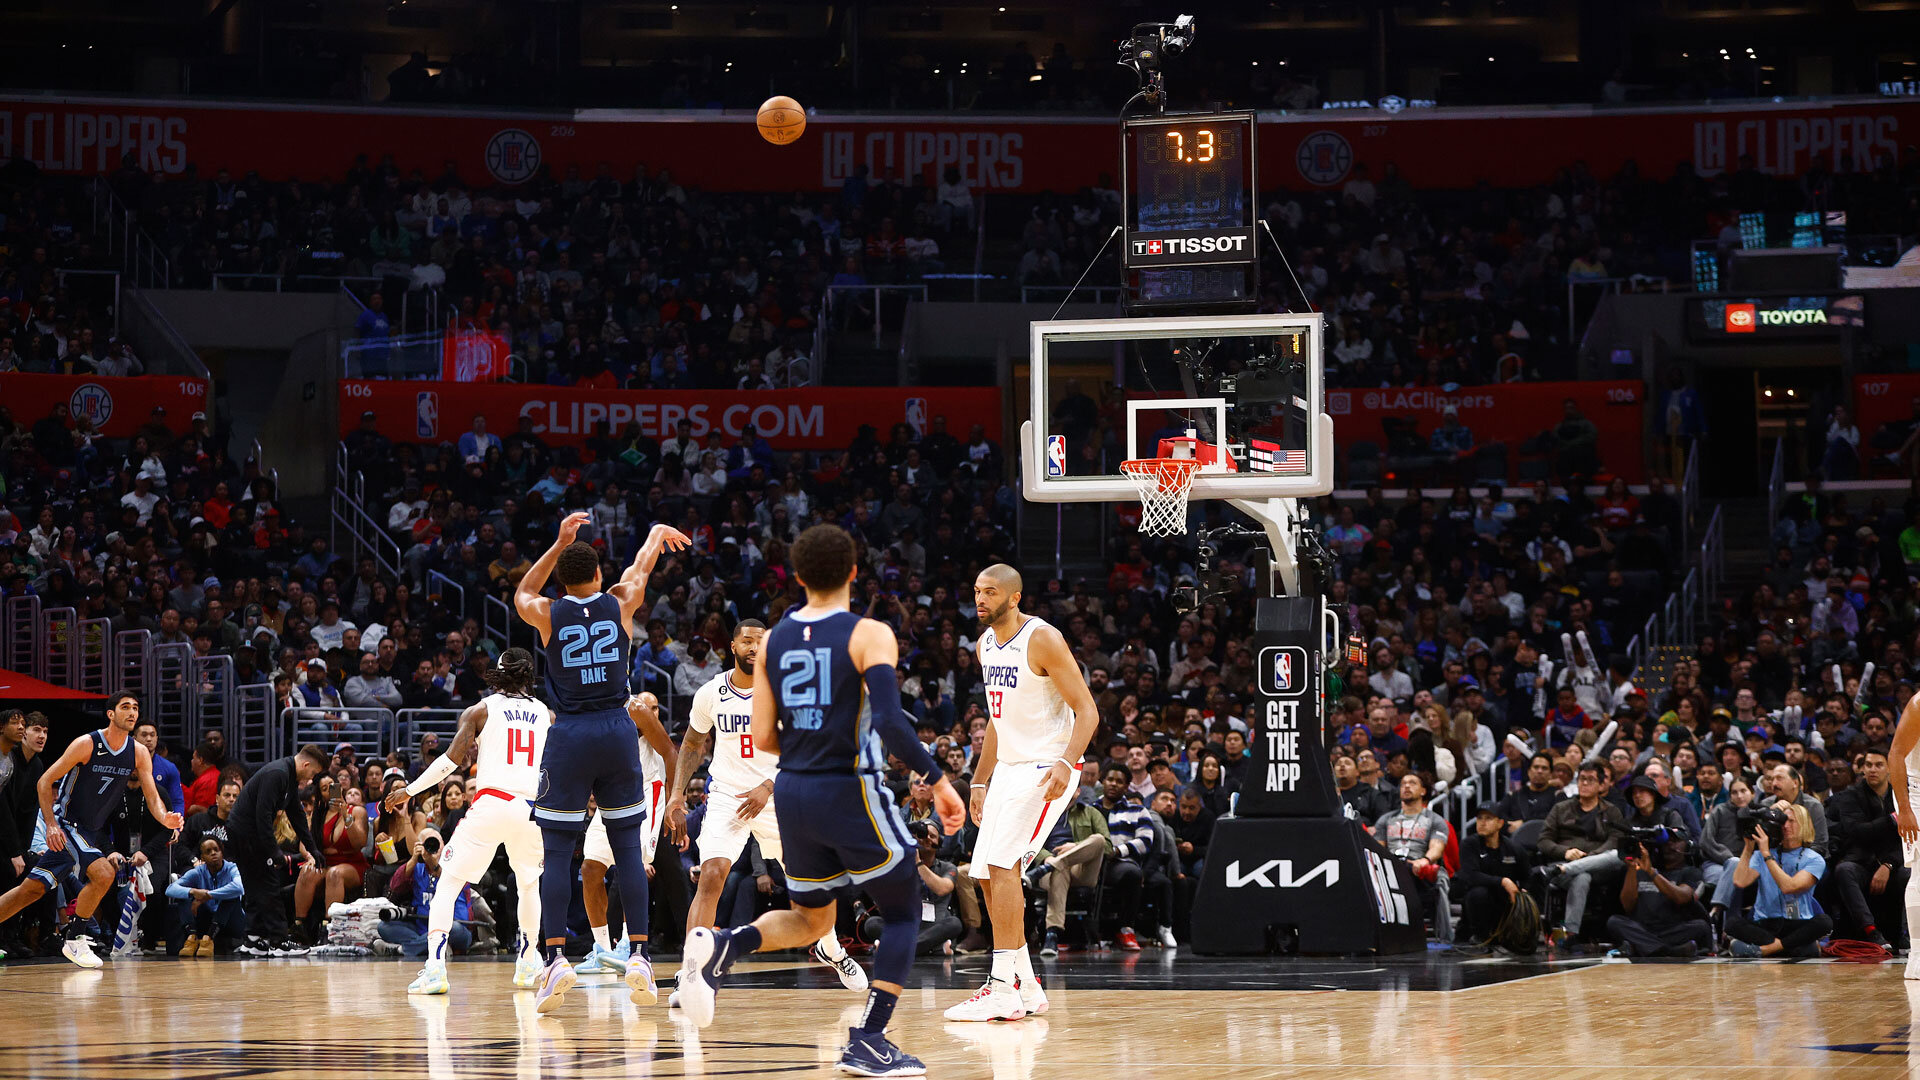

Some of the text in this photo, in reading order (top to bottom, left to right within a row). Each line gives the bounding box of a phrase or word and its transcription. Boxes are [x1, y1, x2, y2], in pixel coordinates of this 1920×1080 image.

[551, 126, 576, 136] 206
[1362, 125, 1388, 137] 207
[24, 112, 187, 174] CLIPPERS
[1166, 130, 1214, 162] 7.3
[1693, 115, 1899, 178] LA CLIPPERS
[822, 131, 1024, 188] LA CLIPPERS
[1164, 235, 1247, 255] TISSOT
[1759, 309, 1827, 325] TOYOTA
[178, 381, 204, 397] 105
[344, 384, 372, 398] 106
[1606, 387, 1634, 403] 106
[1861, 381, 1889, 396] 107
[1362, 391, 1495, 413] @LAClippers
[519, 400, 825, 438] CLIPPERS.COM
[558, 620, 620, 668] 22
[581, 666, 607, 684] BANE
[779, 647, 832, 707] 21
[989, 691, 1003, 719] 33
[1266, 700, 1300, 730] GET
[503, 710, 538, 725] MANN
[717, 713, 752, 733] CLIPP
[507, 728, 535, 767] 14
[740, 734, 754, 758] 8
[1266, 731, 1300, 761] THE
[92, 764, 132, 776] GRIZZLIES
[1265, 762, 1301, 792] APP
[98, 776, 115, 795] 7
[1226, 859, 1340, 888] KIA
